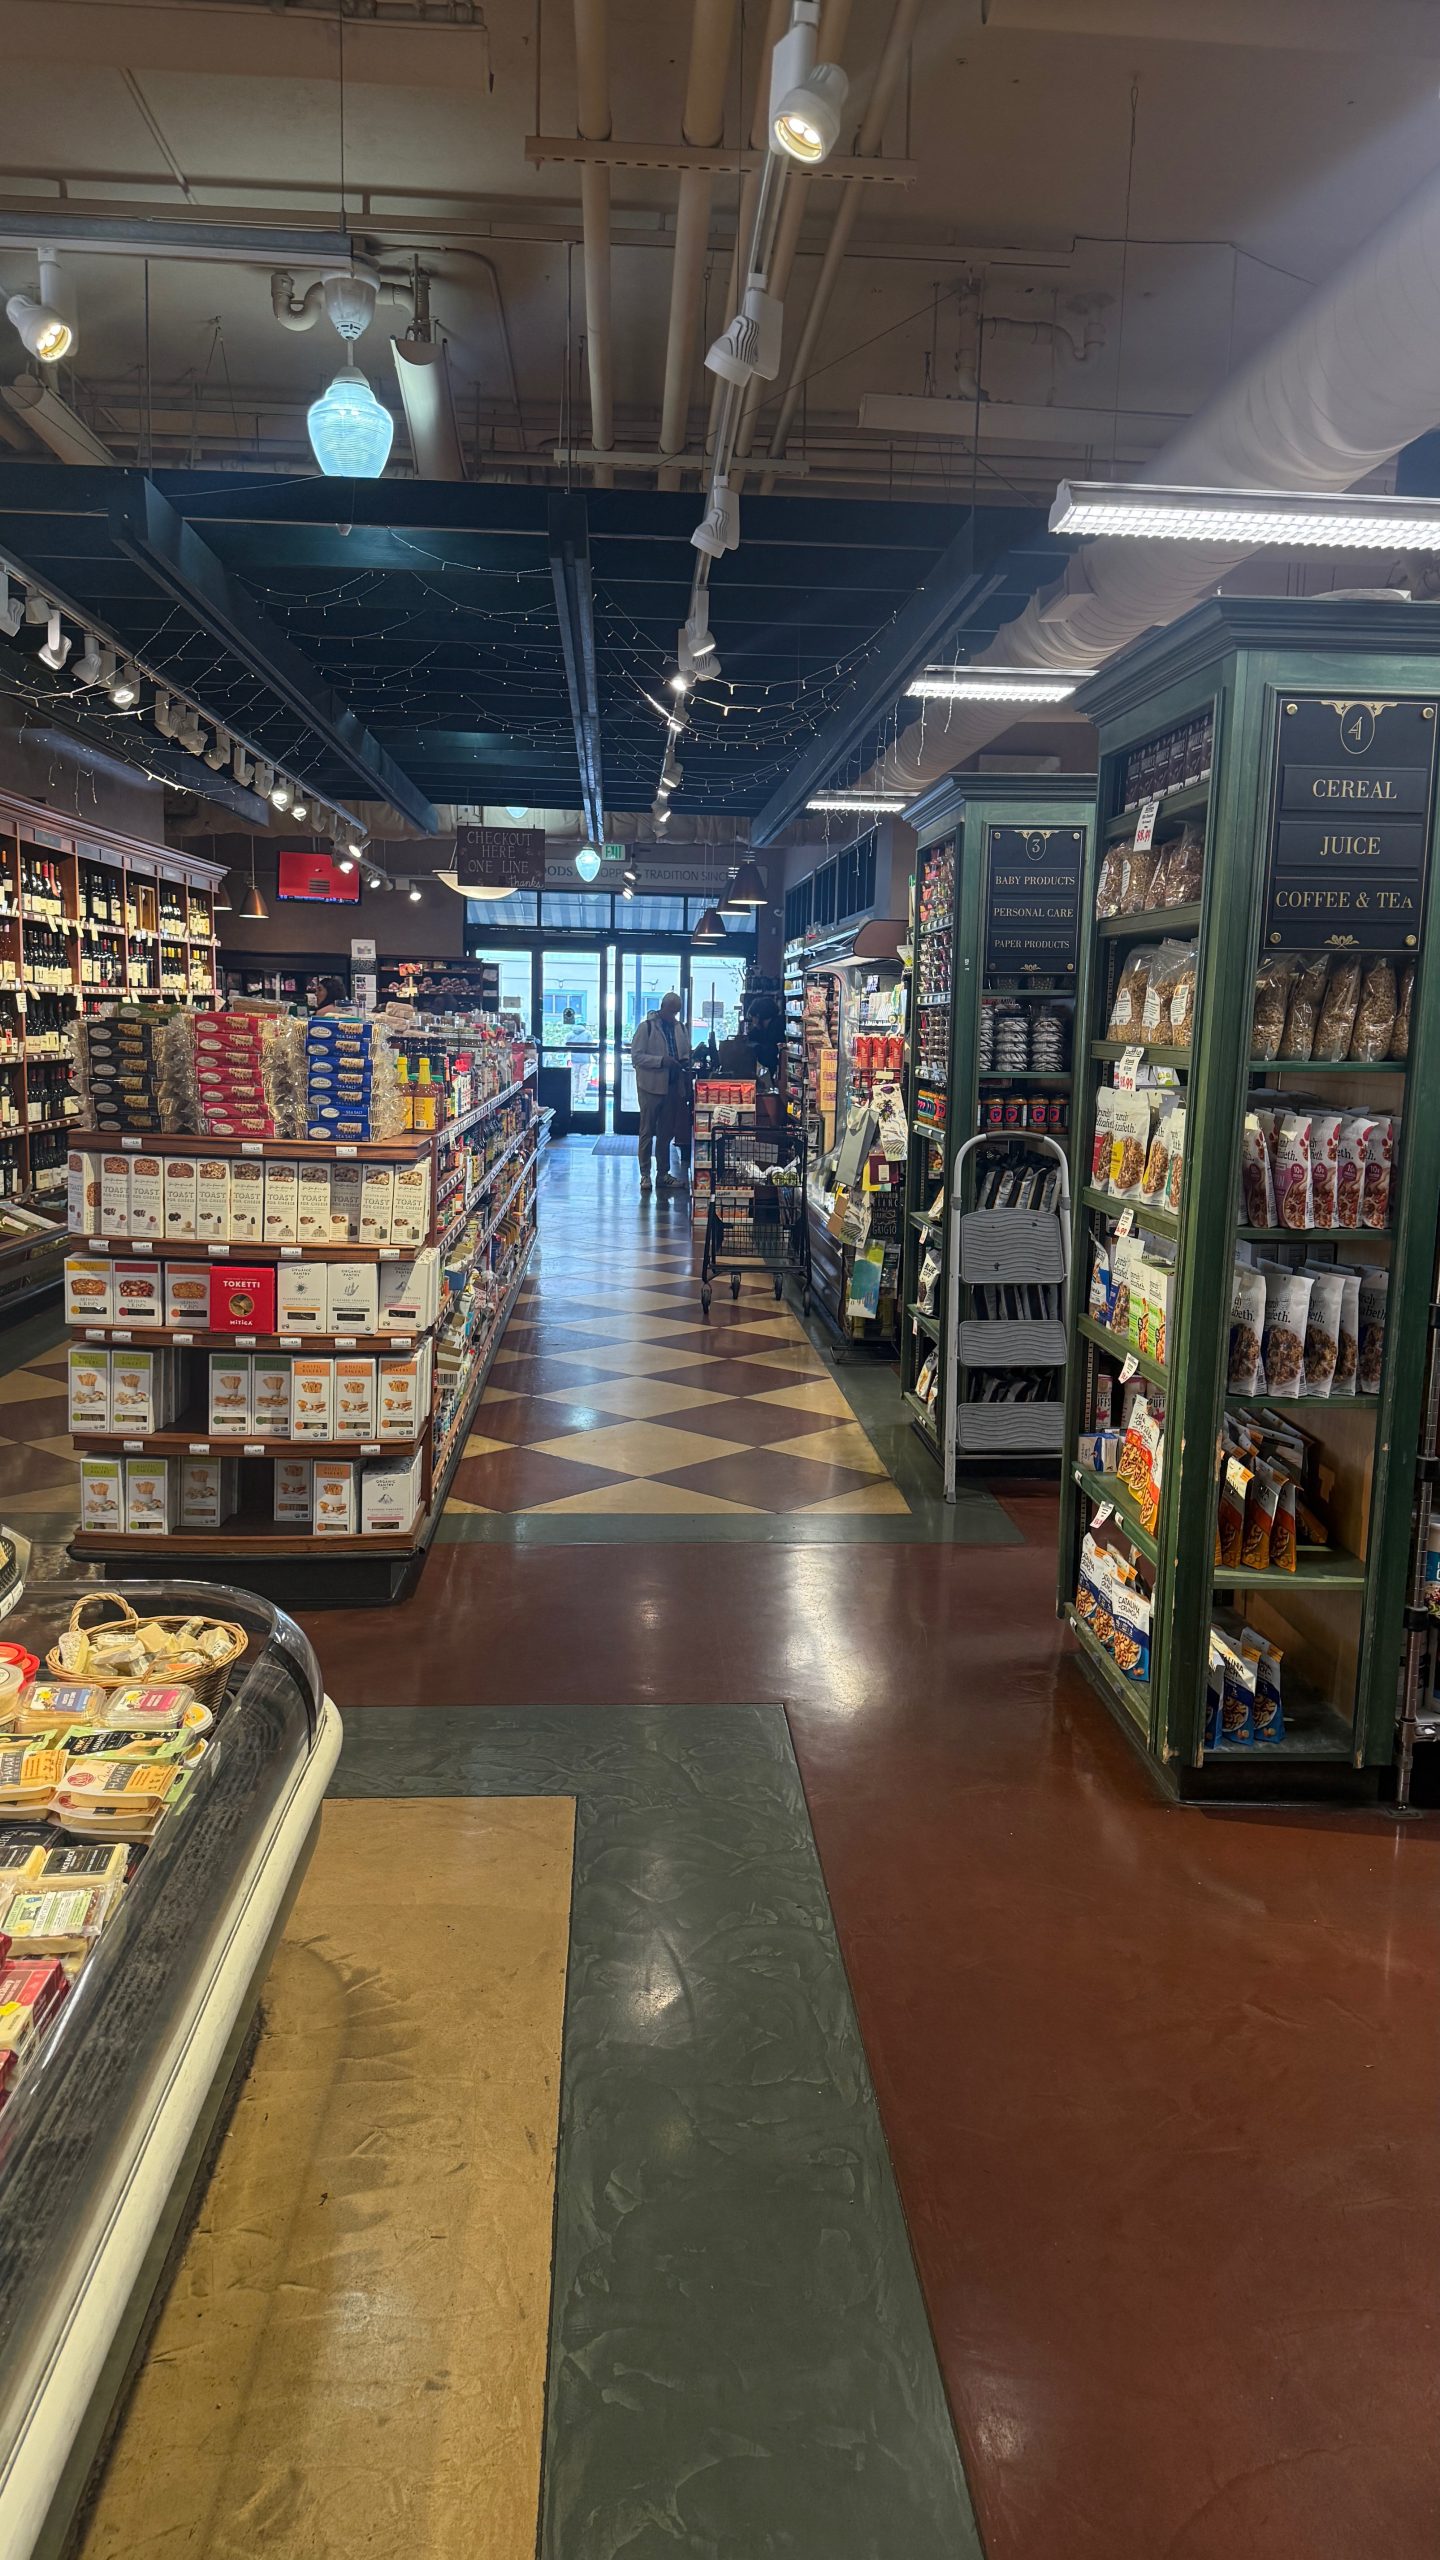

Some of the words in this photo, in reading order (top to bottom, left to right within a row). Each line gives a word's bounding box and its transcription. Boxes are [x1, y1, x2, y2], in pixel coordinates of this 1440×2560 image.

[1348, 716, 1363, 740] 4
[1312, 779, 1398, 800] CEREAL
[467, 831, 532, 846] CHECKOUT
[482, 845, 516, 859] HERE
[605, 845, 622, 859] EXIT
[1032, 839, 1041, 853] 3
[1320, 836, 1381, 856] JUICE
[468, 860, 493, 873] ONE
[502, 860, 529, 874] LINE
[644, 869, 698, 881] TRADITION
[702, 872, 730, 882] SINC
[996, 876, 1021, 885] BABY
[1024, 876, 1076, 886] PRODUCTS
[1275, 890, 1351, 909] COFFEE
[1355, 892, 1371, 909] &
[1376, 892, 1414, 910] TEA
[994, 907, 1045, 918] PERSONAL
[1046, 908, 1074, 918] CARE
[994, 939, 1022, 948] PAPER
[1024, 940, 1070, 949] PRODUCTS
[134, 1188, 160, 1196] TOAST
[233, 1192, 260, 1200] TOAST
[267, 1194, 295, 1202] TOAST
[363, 1198, 390, 1206] TOAST
[223, 1280, 260, 1288] TOKETTI
[1096, 1398, 1111, 1406] UFFS
[1118, 1596, 1140, 1615] CATALINA
